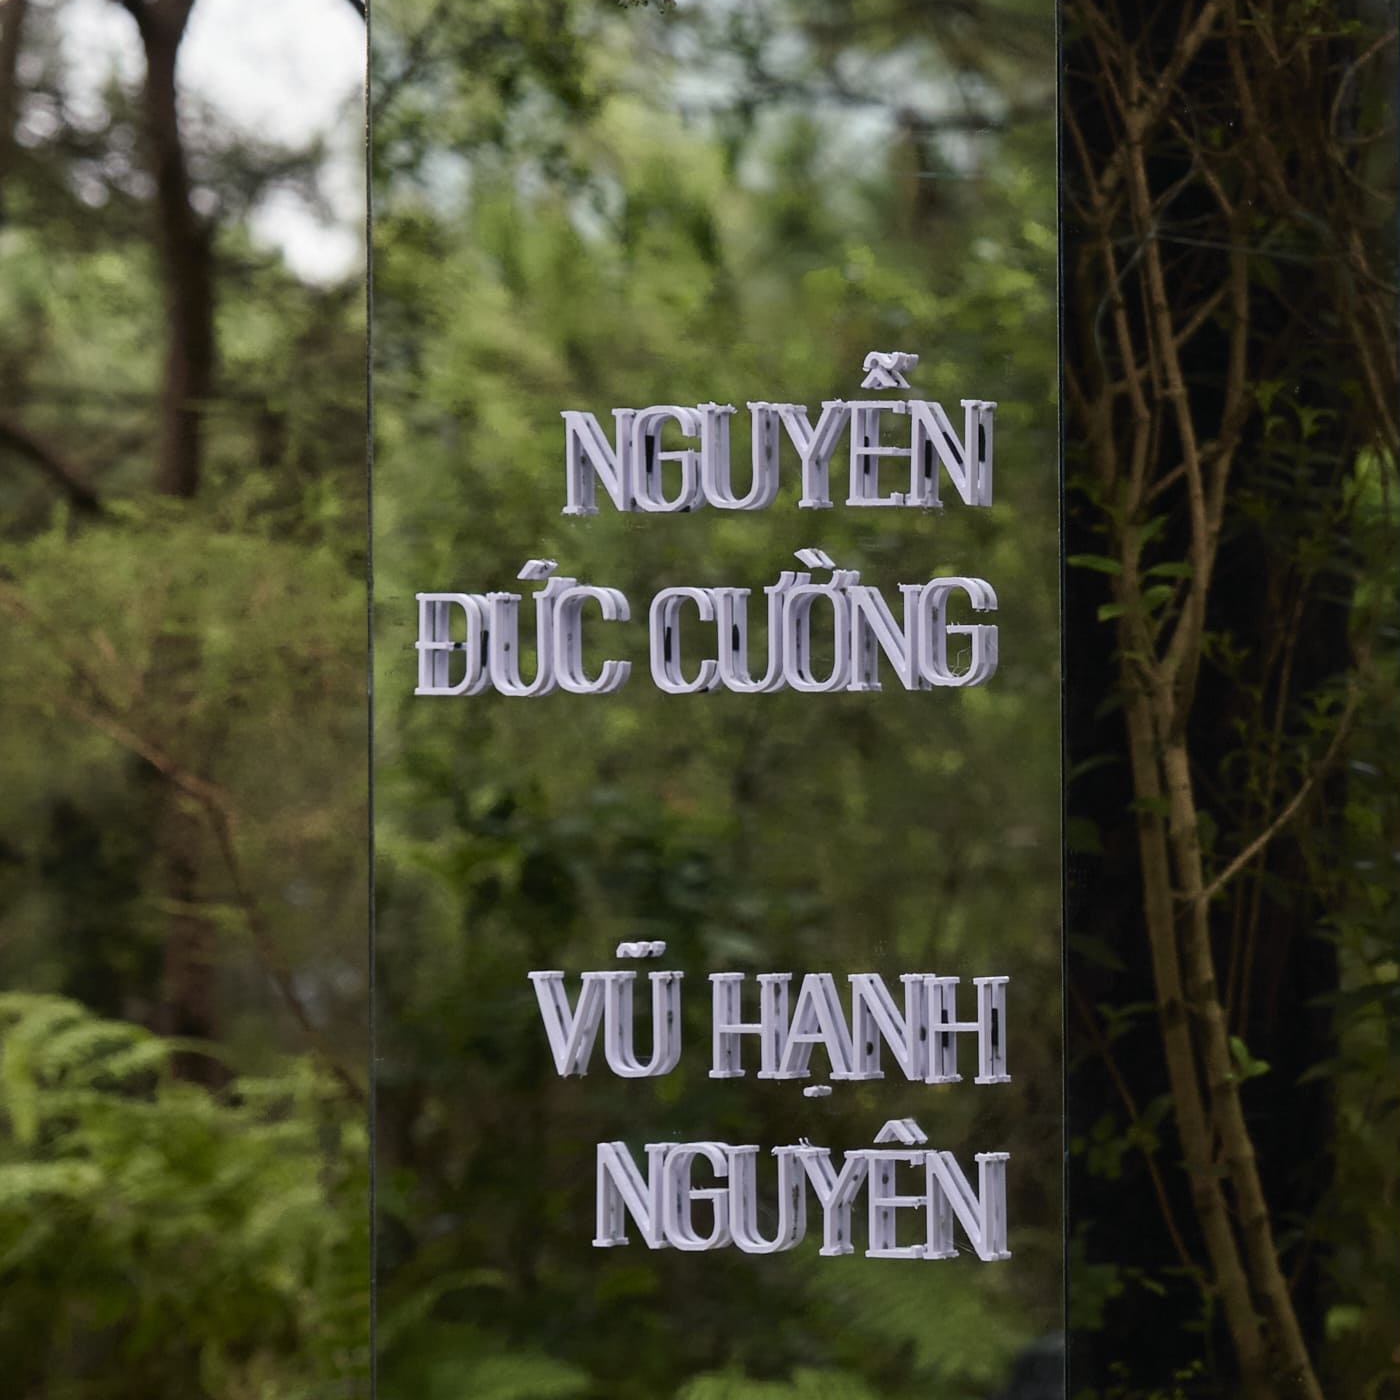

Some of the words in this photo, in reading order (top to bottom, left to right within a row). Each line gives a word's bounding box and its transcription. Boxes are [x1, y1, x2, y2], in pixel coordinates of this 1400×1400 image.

[560, 351, 999, 515] NGUYỄN
[414, 558, 632, 698] ĐỨC
[649, 548, 999, 695] CƯỜNG
[527, 940, 685, 1078] VŨ
[708, 971, 1012, 1097] HẠNH
[592, 1117, 1013, 1262] NGUYÊN
